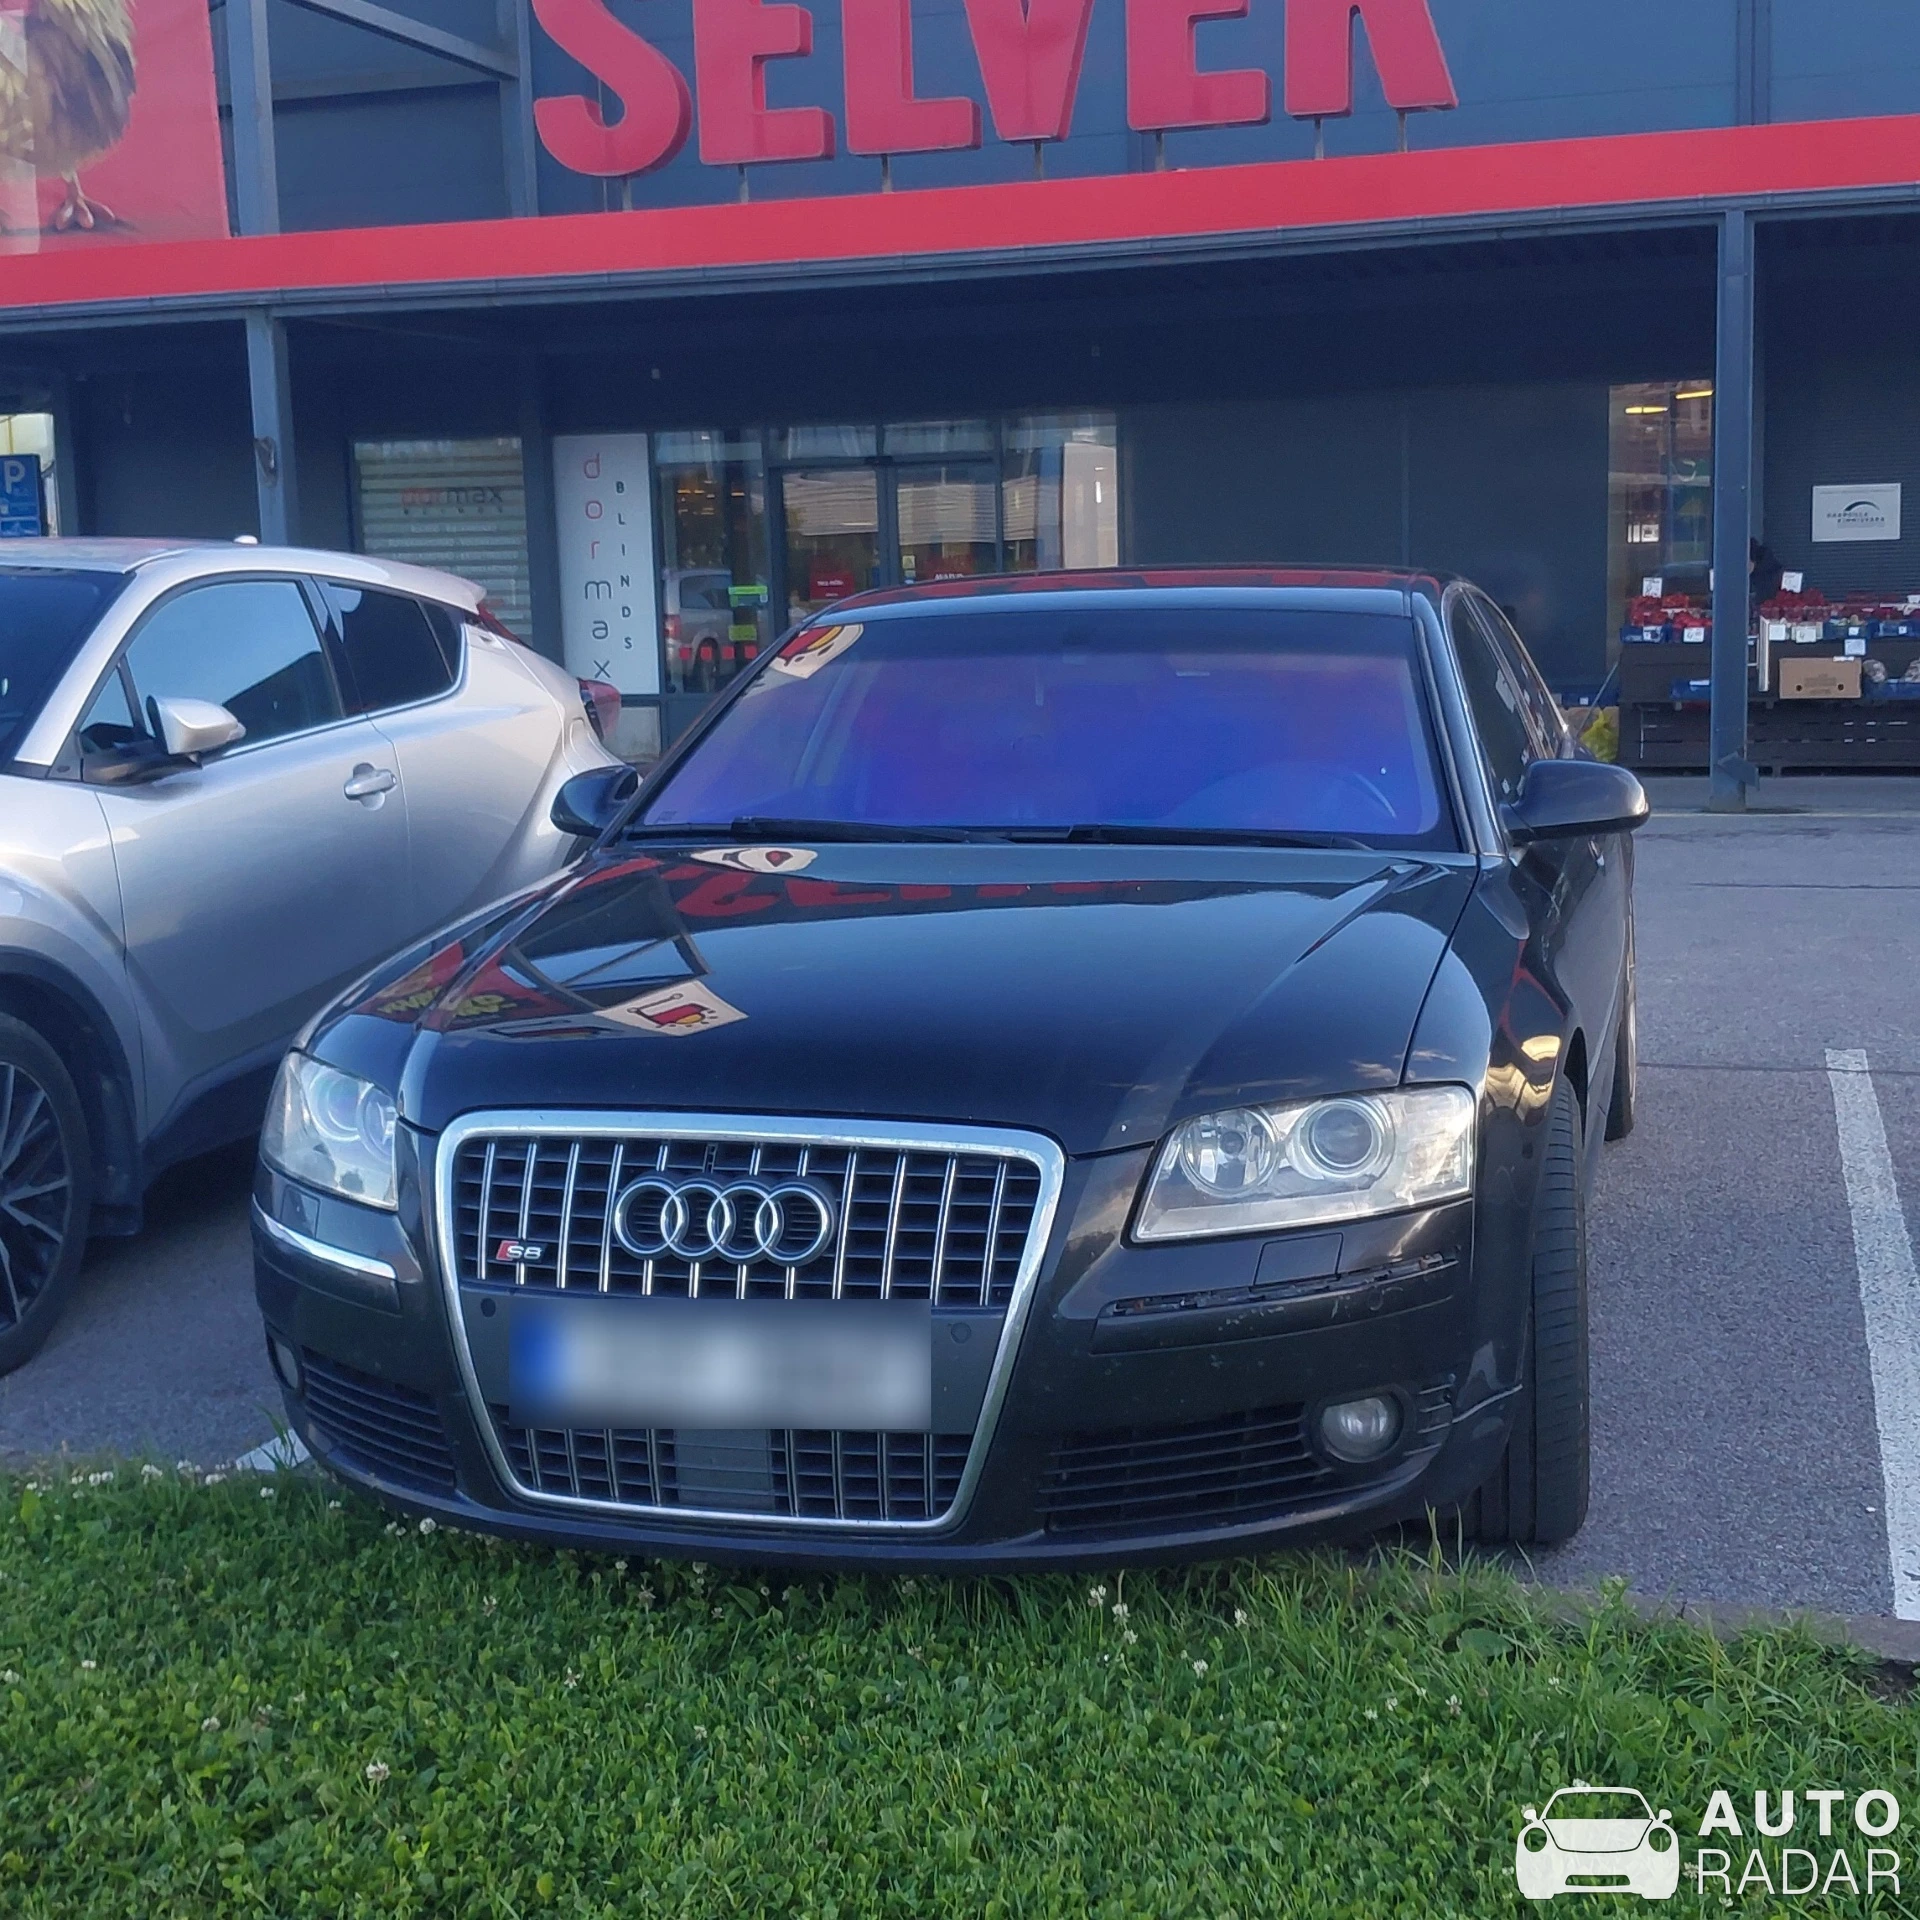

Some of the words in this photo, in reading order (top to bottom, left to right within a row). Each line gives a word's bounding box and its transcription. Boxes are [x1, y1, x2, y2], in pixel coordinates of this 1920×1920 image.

[4, 460, 26, 495] P
[583, 453, 613, 679] dormax
[616, 481, 633, 650] BLINDS
[506, 1245, 542, 1260] S8
